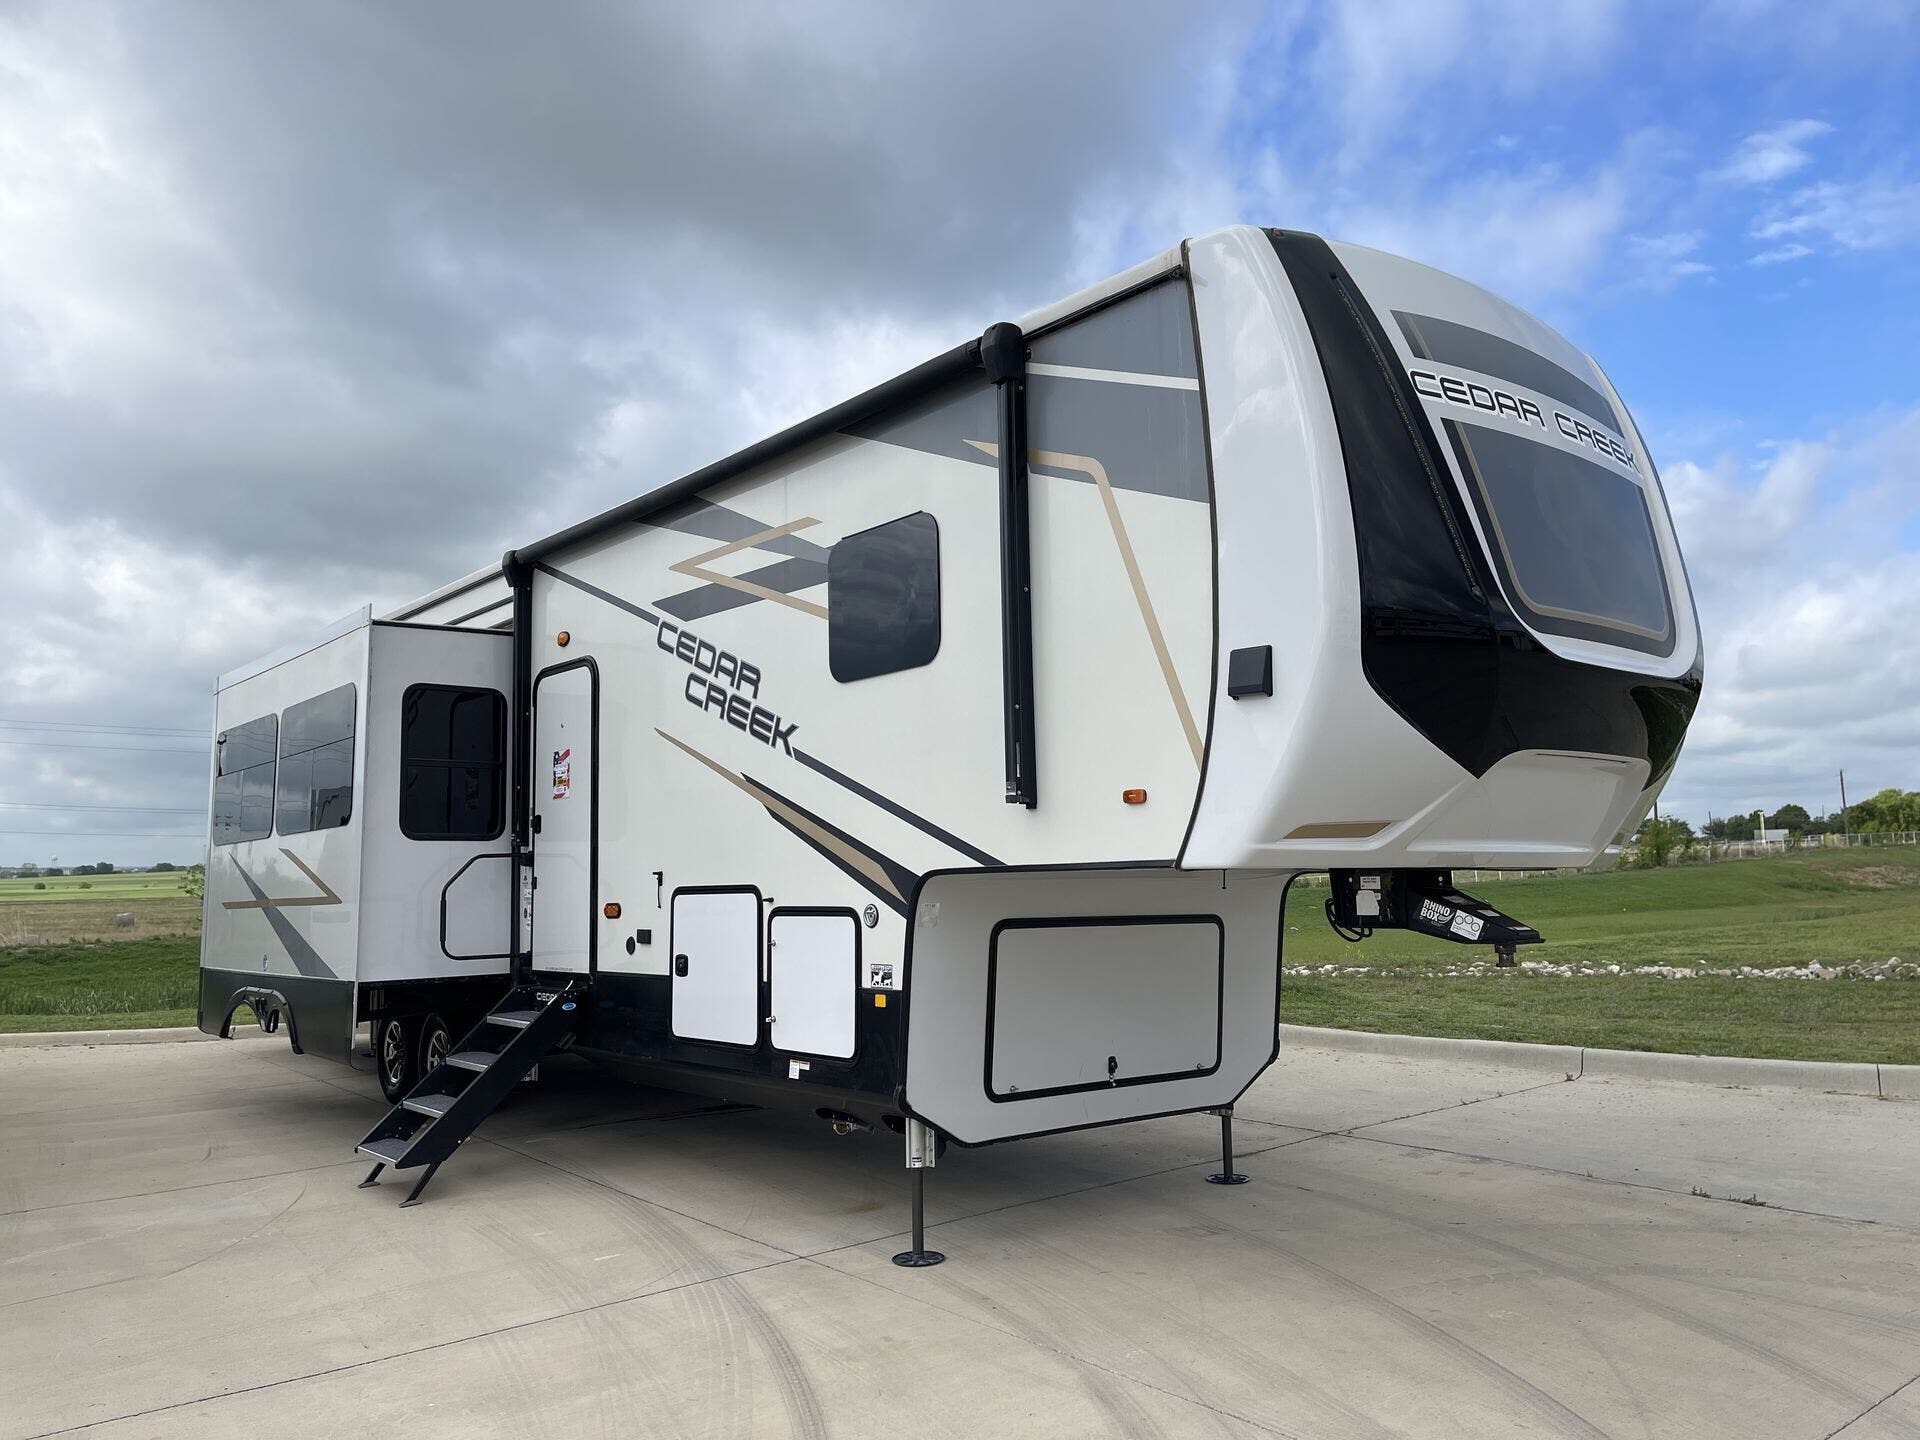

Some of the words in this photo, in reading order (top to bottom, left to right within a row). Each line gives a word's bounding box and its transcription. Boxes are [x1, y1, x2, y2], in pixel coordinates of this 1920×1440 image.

[1409, 370, 1546, 428] CEDAR
[1553, 411, 1642, 474] CREEK
[656, 620, 762, 700] CEDAR
[684, 671, 800, 758] CREEK
[1420, 907, 1440, 922] BOX
[1423, 899, 1451, 917] RHINO
[536, 992, 558, 1001] CED
